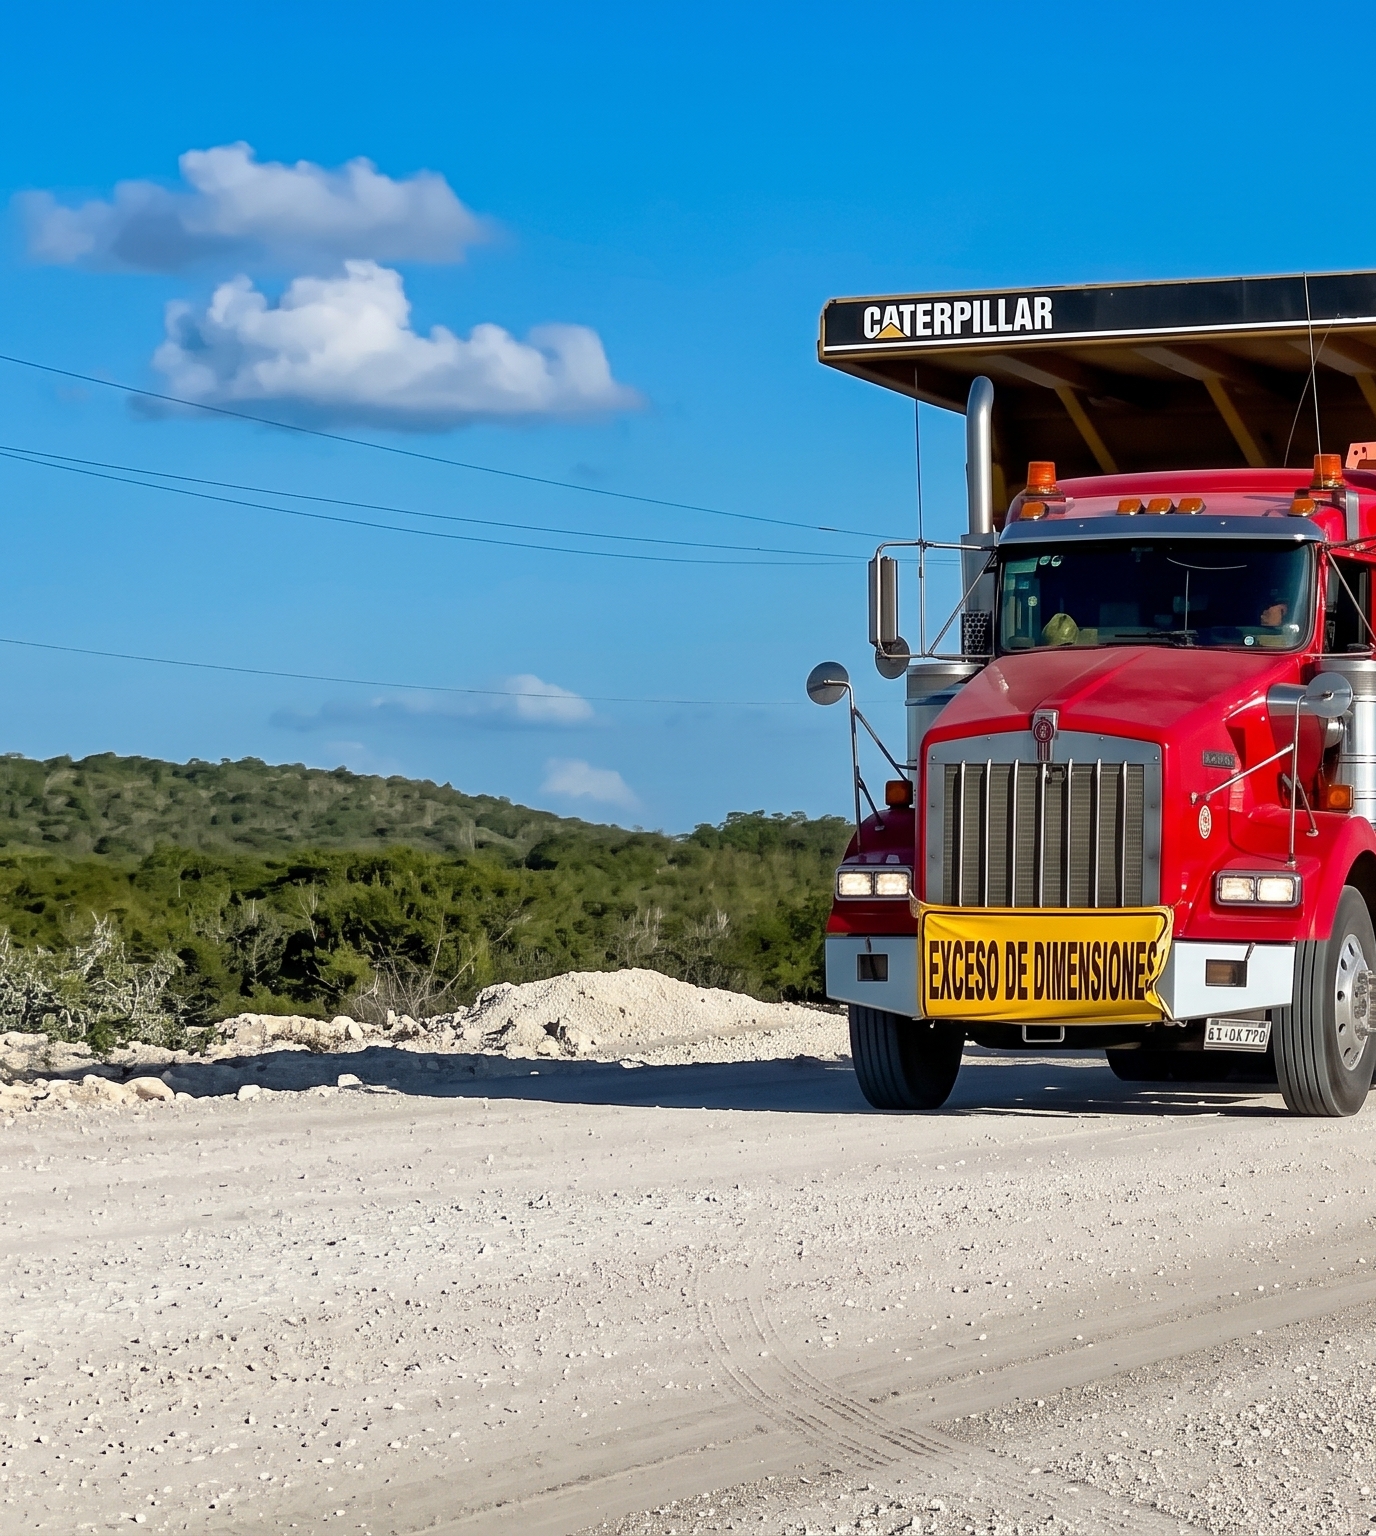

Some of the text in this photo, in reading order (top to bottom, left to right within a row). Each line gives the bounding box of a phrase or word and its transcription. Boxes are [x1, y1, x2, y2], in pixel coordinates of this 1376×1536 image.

[864, 297, 1052, 339] CATERPILLAR
[929, 940, 999, 1001] EXCESO
[1005, 941, 1028, 1000] DE
